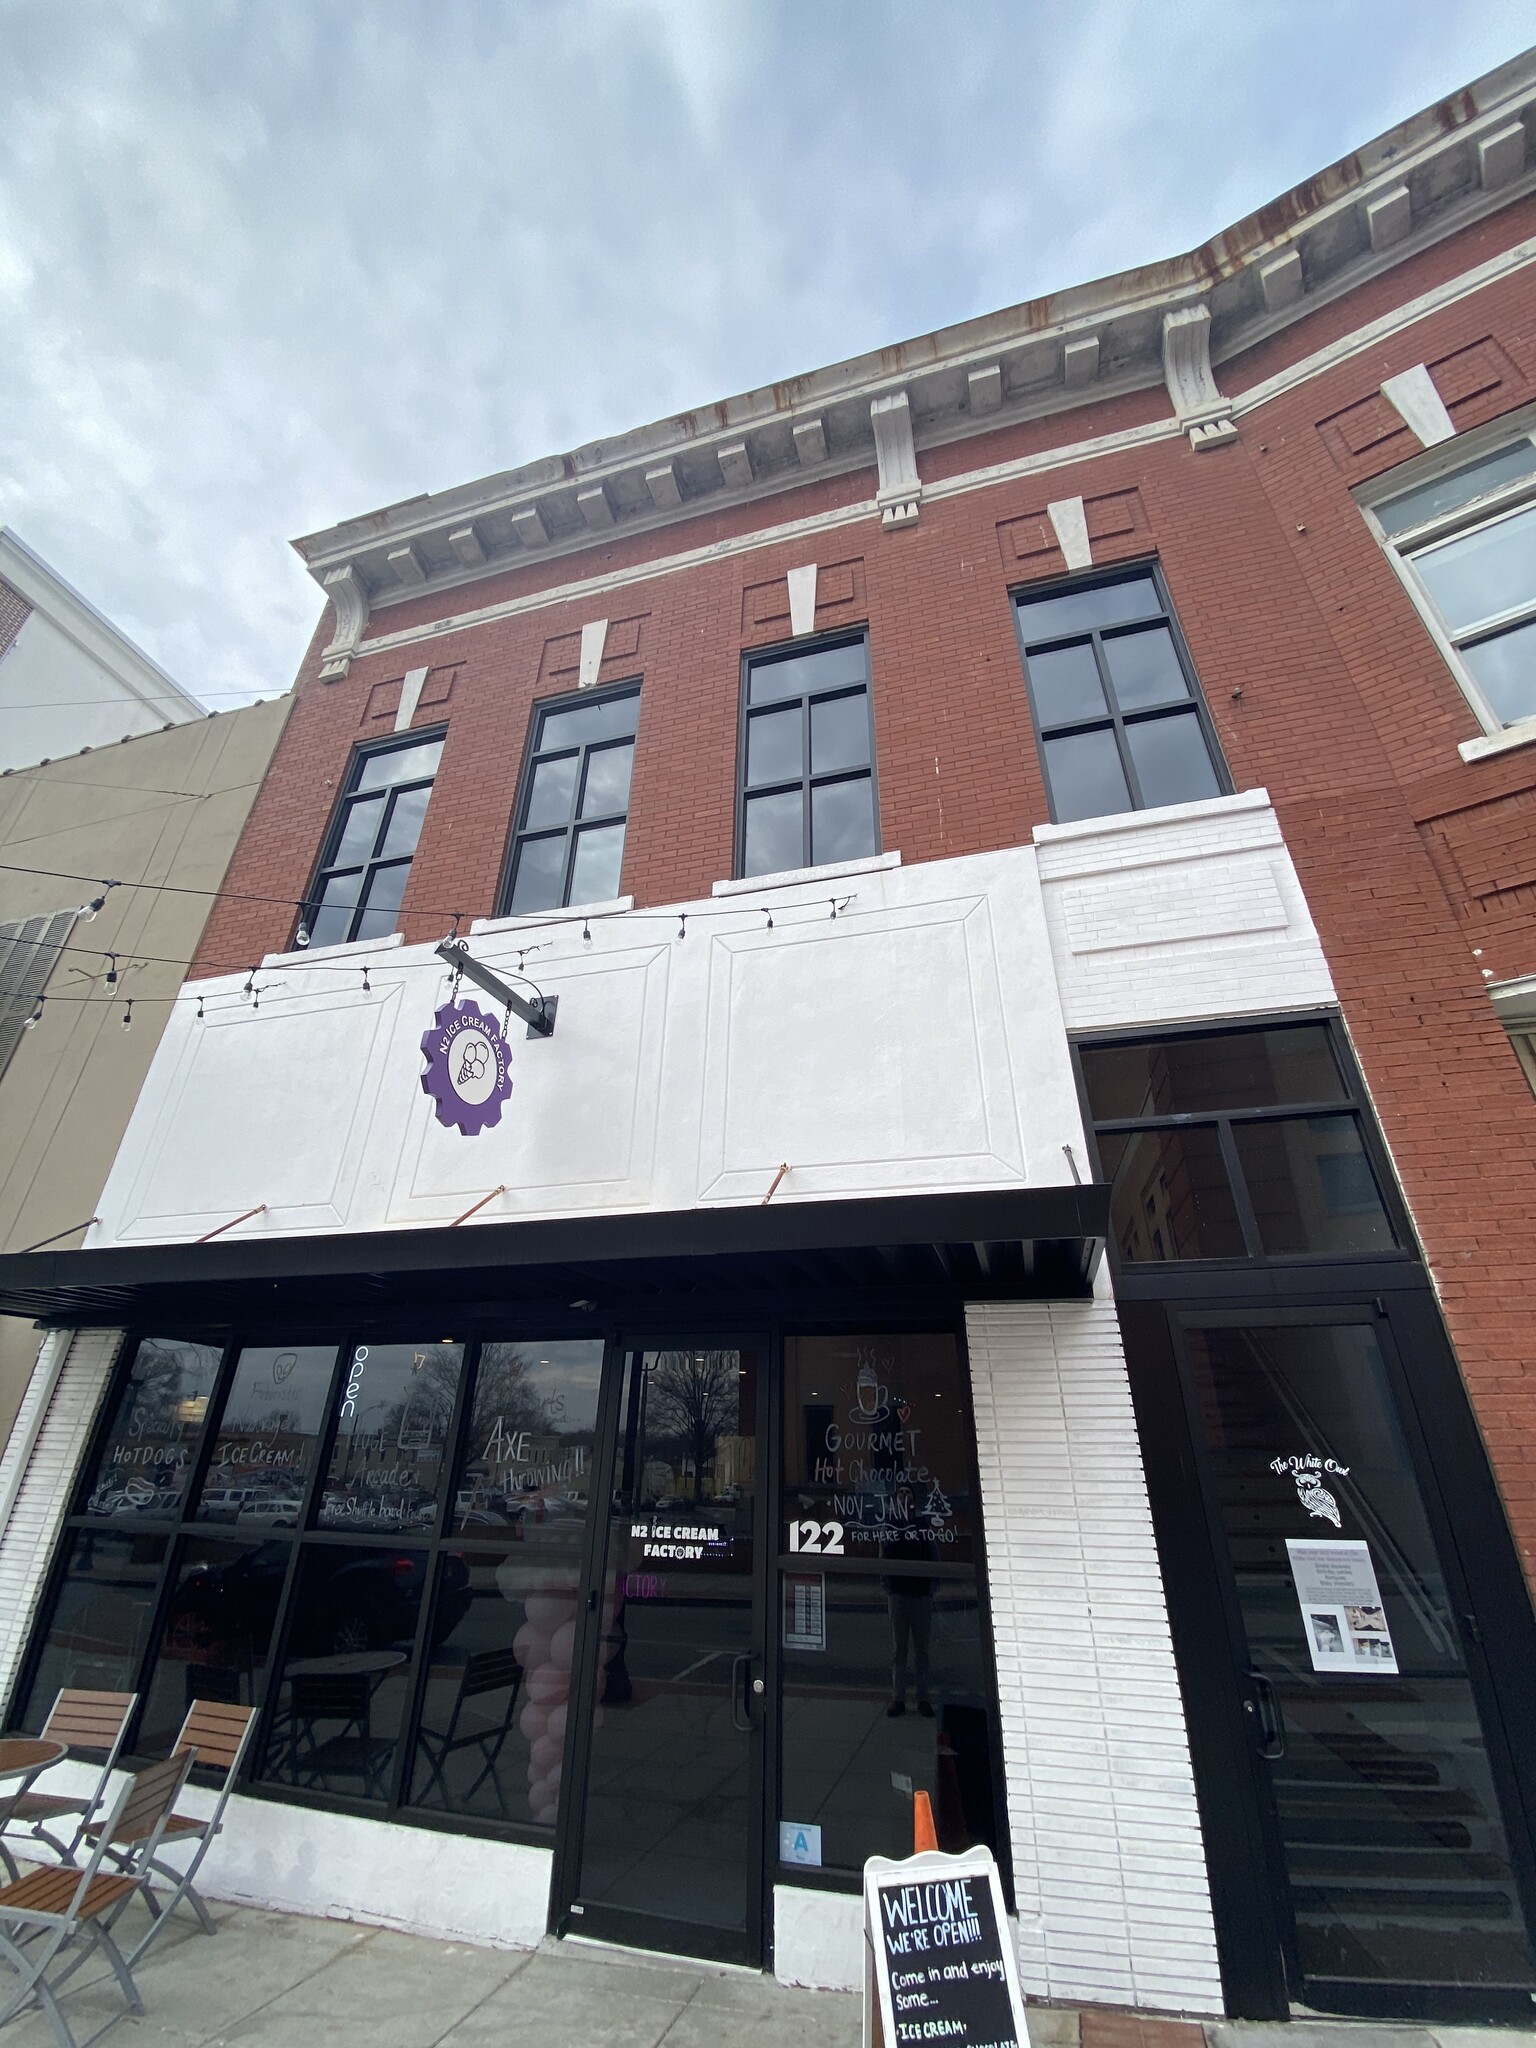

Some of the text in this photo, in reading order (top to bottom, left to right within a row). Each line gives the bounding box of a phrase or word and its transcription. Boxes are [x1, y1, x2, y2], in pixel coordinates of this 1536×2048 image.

[439, 1015, 505, 1092] N2 ICE CREAM FACTORY
[825, 1423, 922, 1457] GOURMET
[218, 1441, 249, 1468] ICE
[1270, 1453, 1350, 1477] The White Owl
[814, 1457, 932, 1485] Hot Chocolate
[631, 1524, 648, 1538] N2
[673, 1526, 719, 1541] CREAM
[789, 1520, 845, 1555] 122
[851, 1531, 871, 1542] FOR
[873, 1530, 901, 1542] HERE
[904, 1531, 920, 1541] OR
[643, 1543, 704, 1560] FACTORY
[794, 1831, 809, 1852] A
[882, 1879, 978, 1927] WELCOME
[886, 1917, 982, 1954] WE'RE OPEN!!!
[891, 1957, 1006, 1991] Come in and enjoy
[898, 2019, 964, 2041] ICE CREAM
